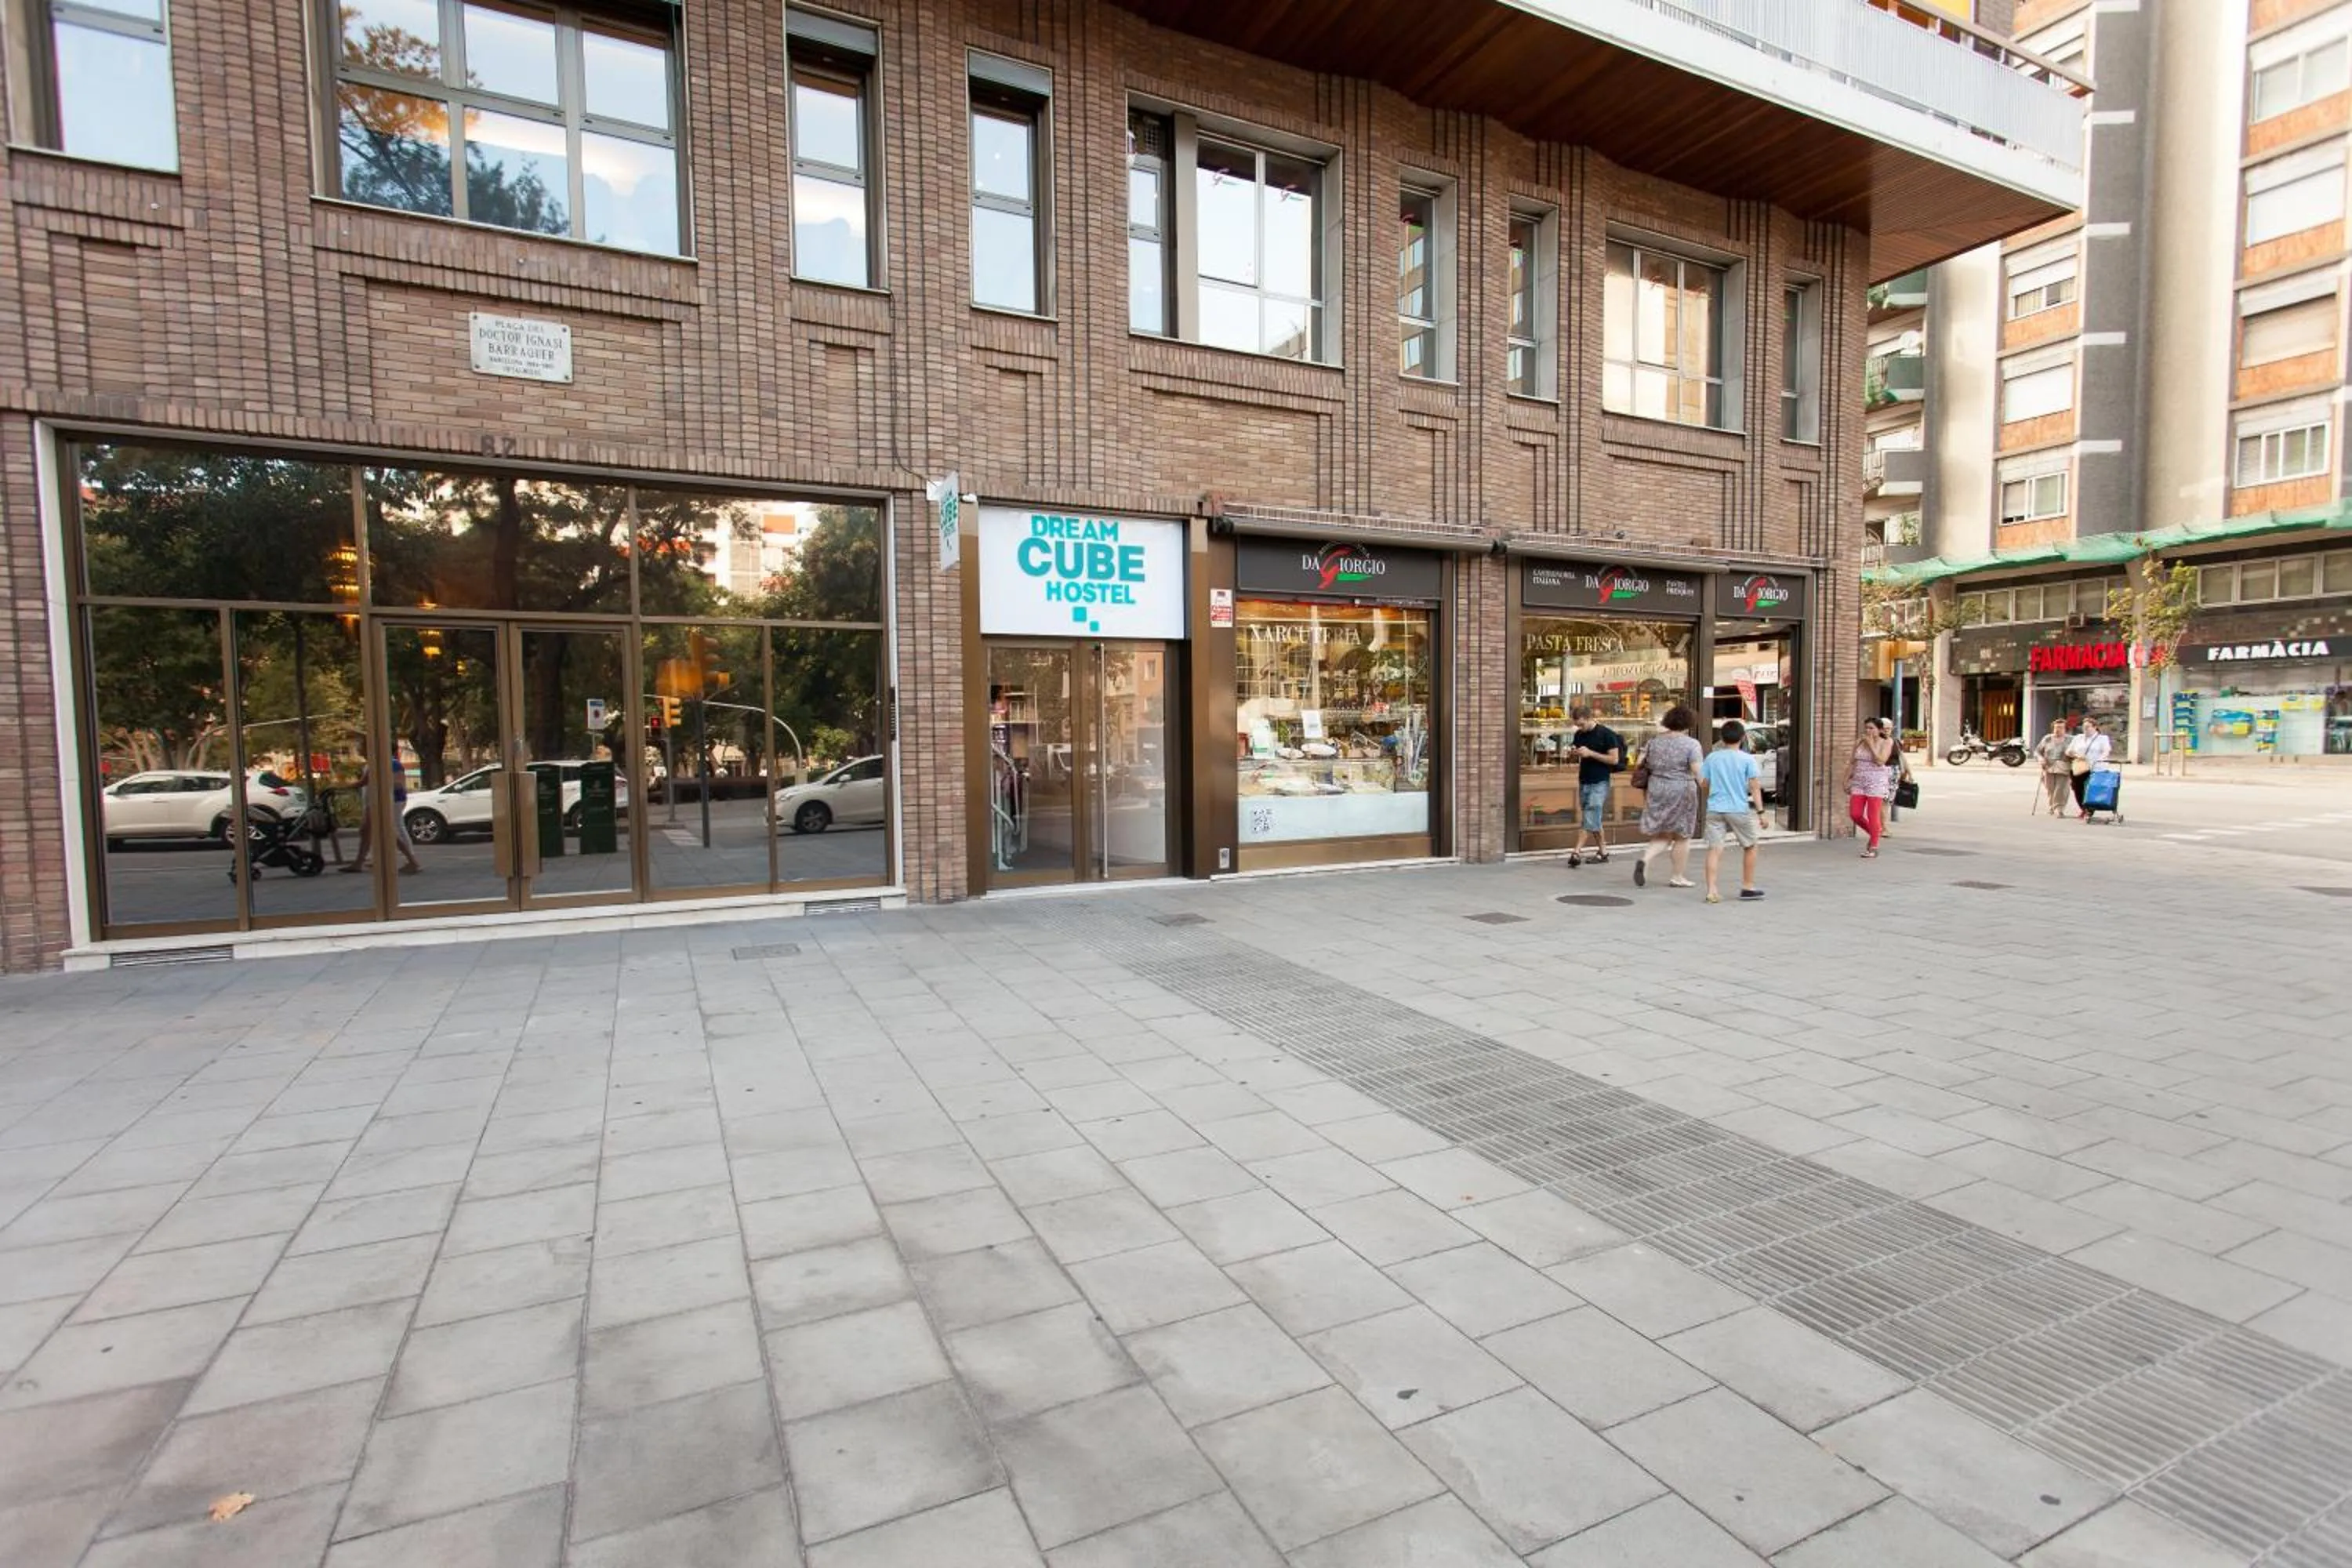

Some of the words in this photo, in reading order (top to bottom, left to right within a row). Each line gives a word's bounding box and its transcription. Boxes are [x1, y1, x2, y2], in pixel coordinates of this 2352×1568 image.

[479, 328, 521, 343] DOCTOR
[526, 335, 563, 350] IGNASI
[488, 343, 555, 360] BARRAQUER
[1031, 514, 1119, 543] DREAM
[1017, 537, 1145, 583] CUBE
[1302, 554, 1319, 571] DA
[1046, 581, 1135, 604] HOSTEL
[1584, 575, 1600, 589] DA
[1733, 586, 1747, 598] DA
[1249, 624, 1362, 645] XARCUTERIA
[1526, 633, 1571, 652] PASTA
[1576, 635, 1624, 654] FRESCA
[2207, 640, 2330, 661] FARMÀCIA
